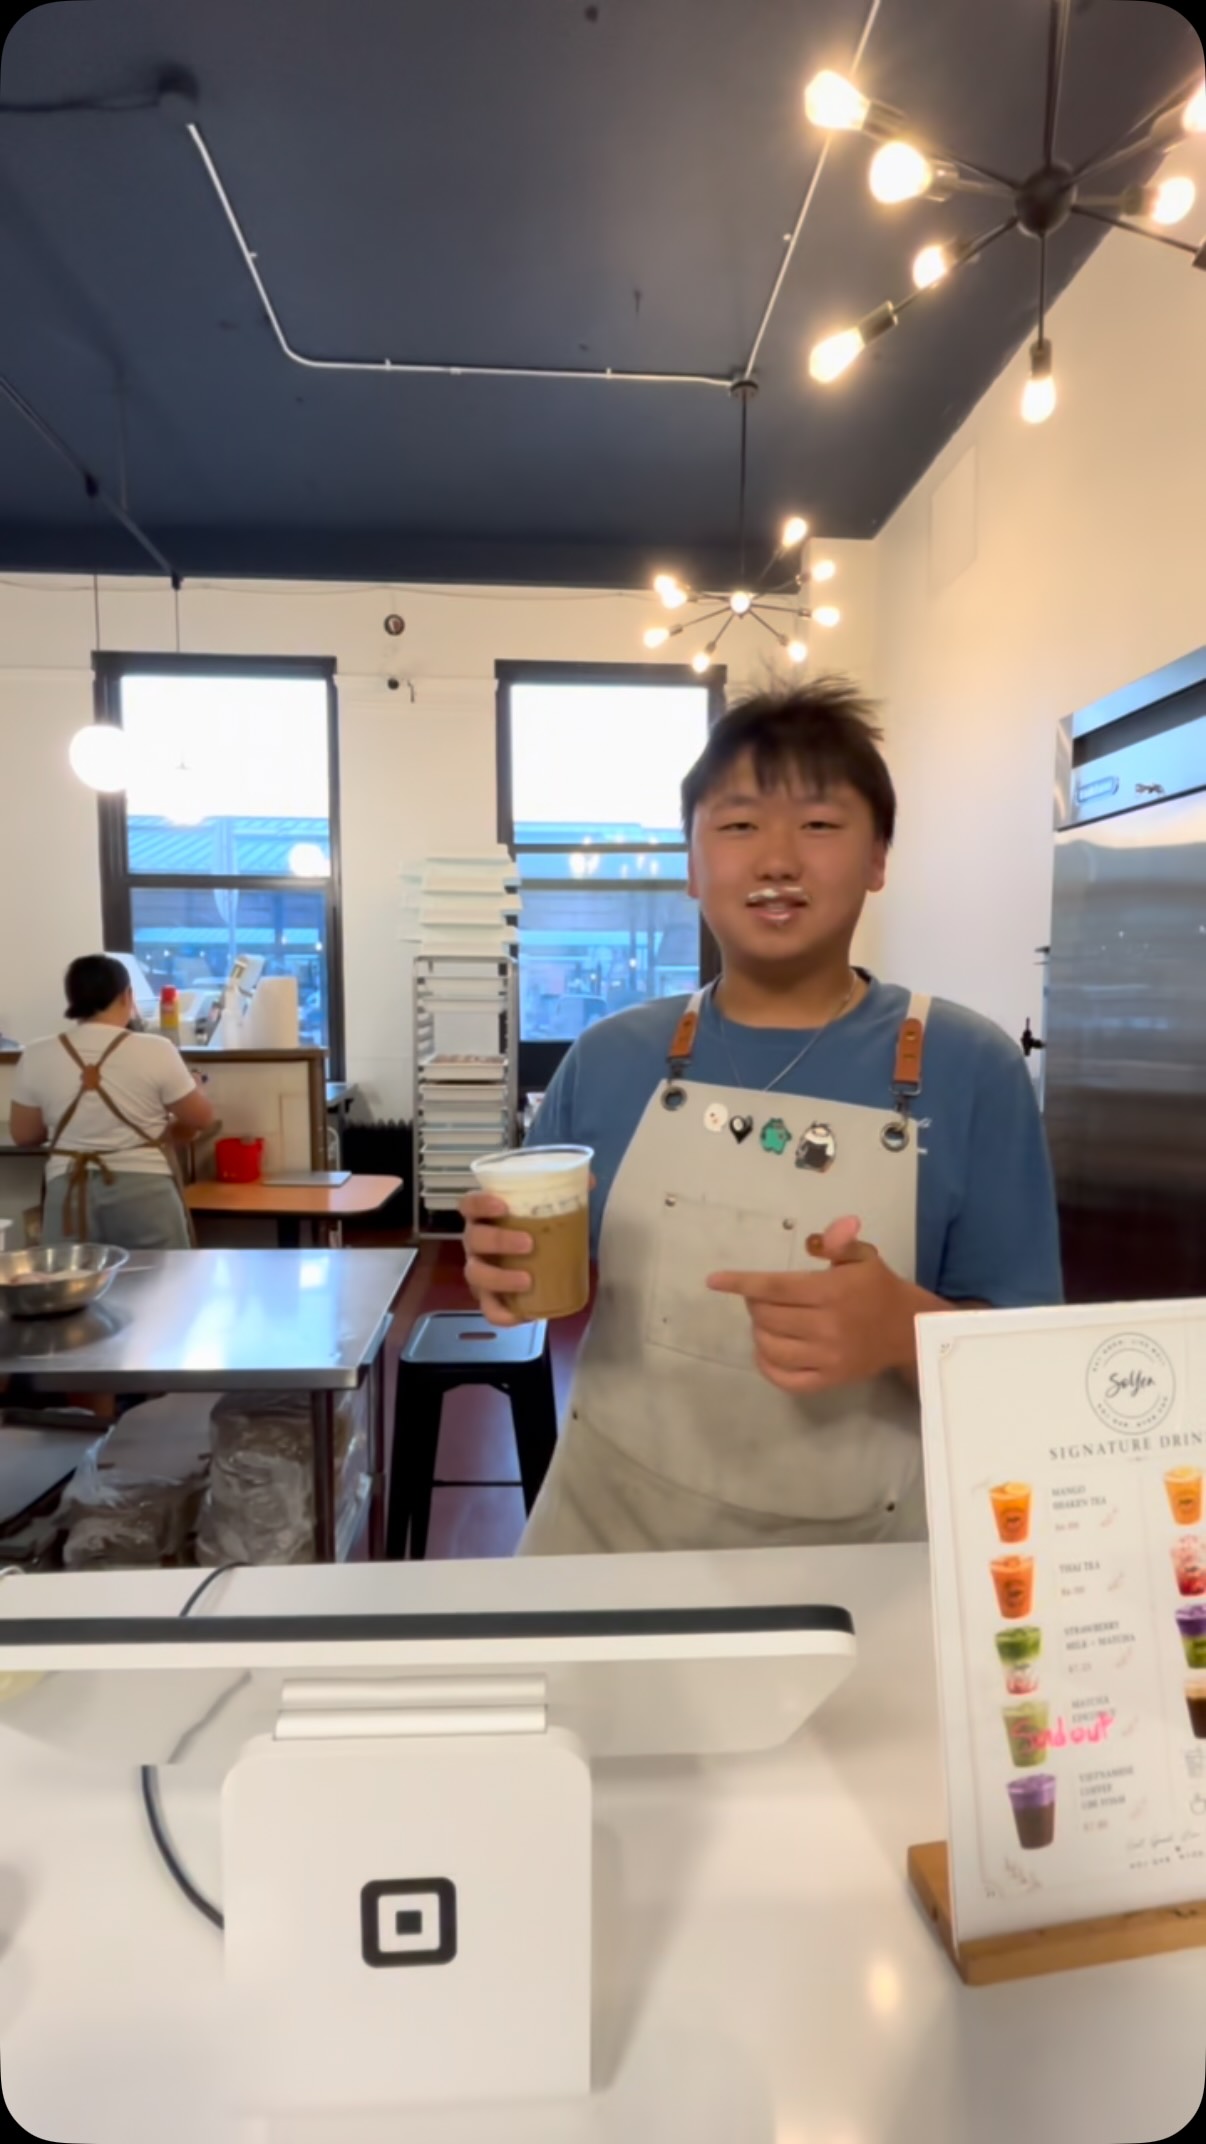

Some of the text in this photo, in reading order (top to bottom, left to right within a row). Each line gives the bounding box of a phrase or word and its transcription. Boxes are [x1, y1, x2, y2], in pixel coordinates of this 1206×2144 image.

[1049, 1437, 1151, 1461] SIGNATURE
[1051, 1485, 1086, 1497] MANGO
[1052, 1496, 1107, 1510] SHAKEN TEA
[1084, 1560, 1101, 1571] TEA
[1064, 1621, 1119, 1635] STRAWBERRY
[1098, 1633, 1136, 1645] MATCHA
[1071, 1696, 1110, 1709] MATCHA
